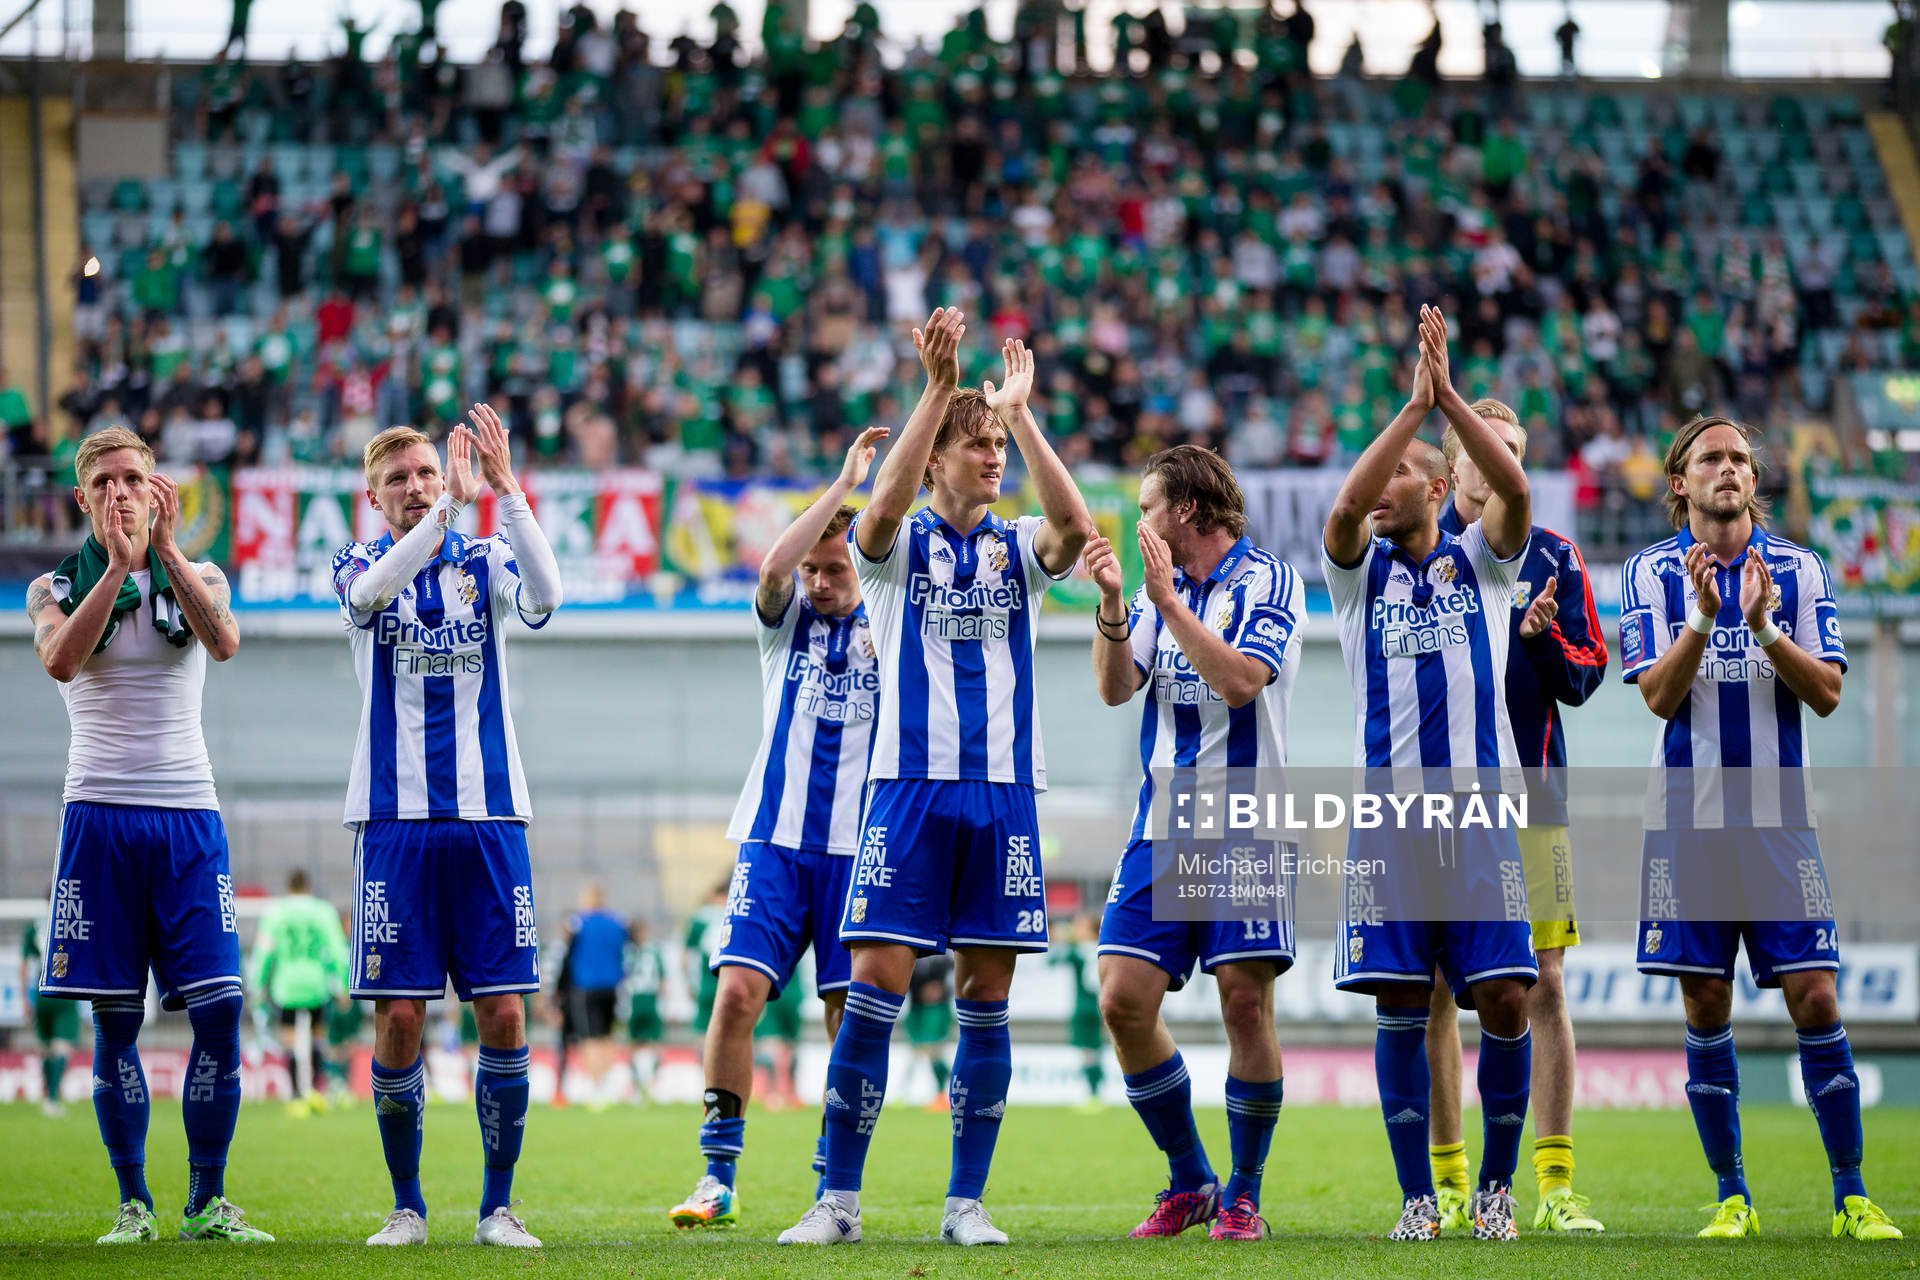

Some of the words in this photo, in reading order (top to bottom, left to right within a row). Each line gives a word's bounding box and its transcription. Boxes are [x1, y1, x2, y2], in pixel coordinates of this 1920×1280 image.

[1219, 557, 1237, 575] ATEA
[1775, 559, 1799, 568] INTER
[912, 574, 1021, 610] Prioritet
[1373, 584, 1479, 629] Prioritet
[924, 610, 1006, 639] Finans
[1255, 618, 1287, 643] GP
[1384, 625, 1467, 656] Finans
[394, 648, 483, 675] Finans
[788, 651, 881, 696] Priorite
[796, 687, 874, 721] Finans
[865, 826, 888, 847] SE
[1007, 836, 1031, 857] SE
[862, 846, 887, 867] RN
[1006, 856, 1034, 877] RN
[856, 866, 893, 888] EKE
[1500, 860, 1522, 881] SE
[1650, 859, 1669, 878] SE
[1797, 859, 1820, 879] SE
[57, 879, 81, 899] SE
[365, 881, 386, 902] SE
[513, 886, 531, 906] SE
[1004, 876, 1042, 898] EKE
[1348, 885, 1374, 906] RN
[1501, 881, 1527, 901] RN
[1649, 879, 1672, 898] RN
[1801, 879, 1827, 898] RN
[56, 899, 83, 920] RN
[364, 902, 389, 922] RN
[515, 906, 534, 926] RN
[1348, 906, 1384, 927] EKE
[1649, 898, 1677, 918] EKE
[1804, 898, 1834, 918] EKE
[54, 919, 90, 940] EKE
[1016, 910, 1045, 933] 28
[1242, 917, 1271, 940] 13
[364, 923, 398, 943] EKE
[1816, 928, 1837, 951] 24
[117, 1058, 145, 1104] SKF
[190, 1051, 218, 1102] SKF
[481, 1084, 501, 1150] SKF
[856, 1079, 882, 1135] SKF
